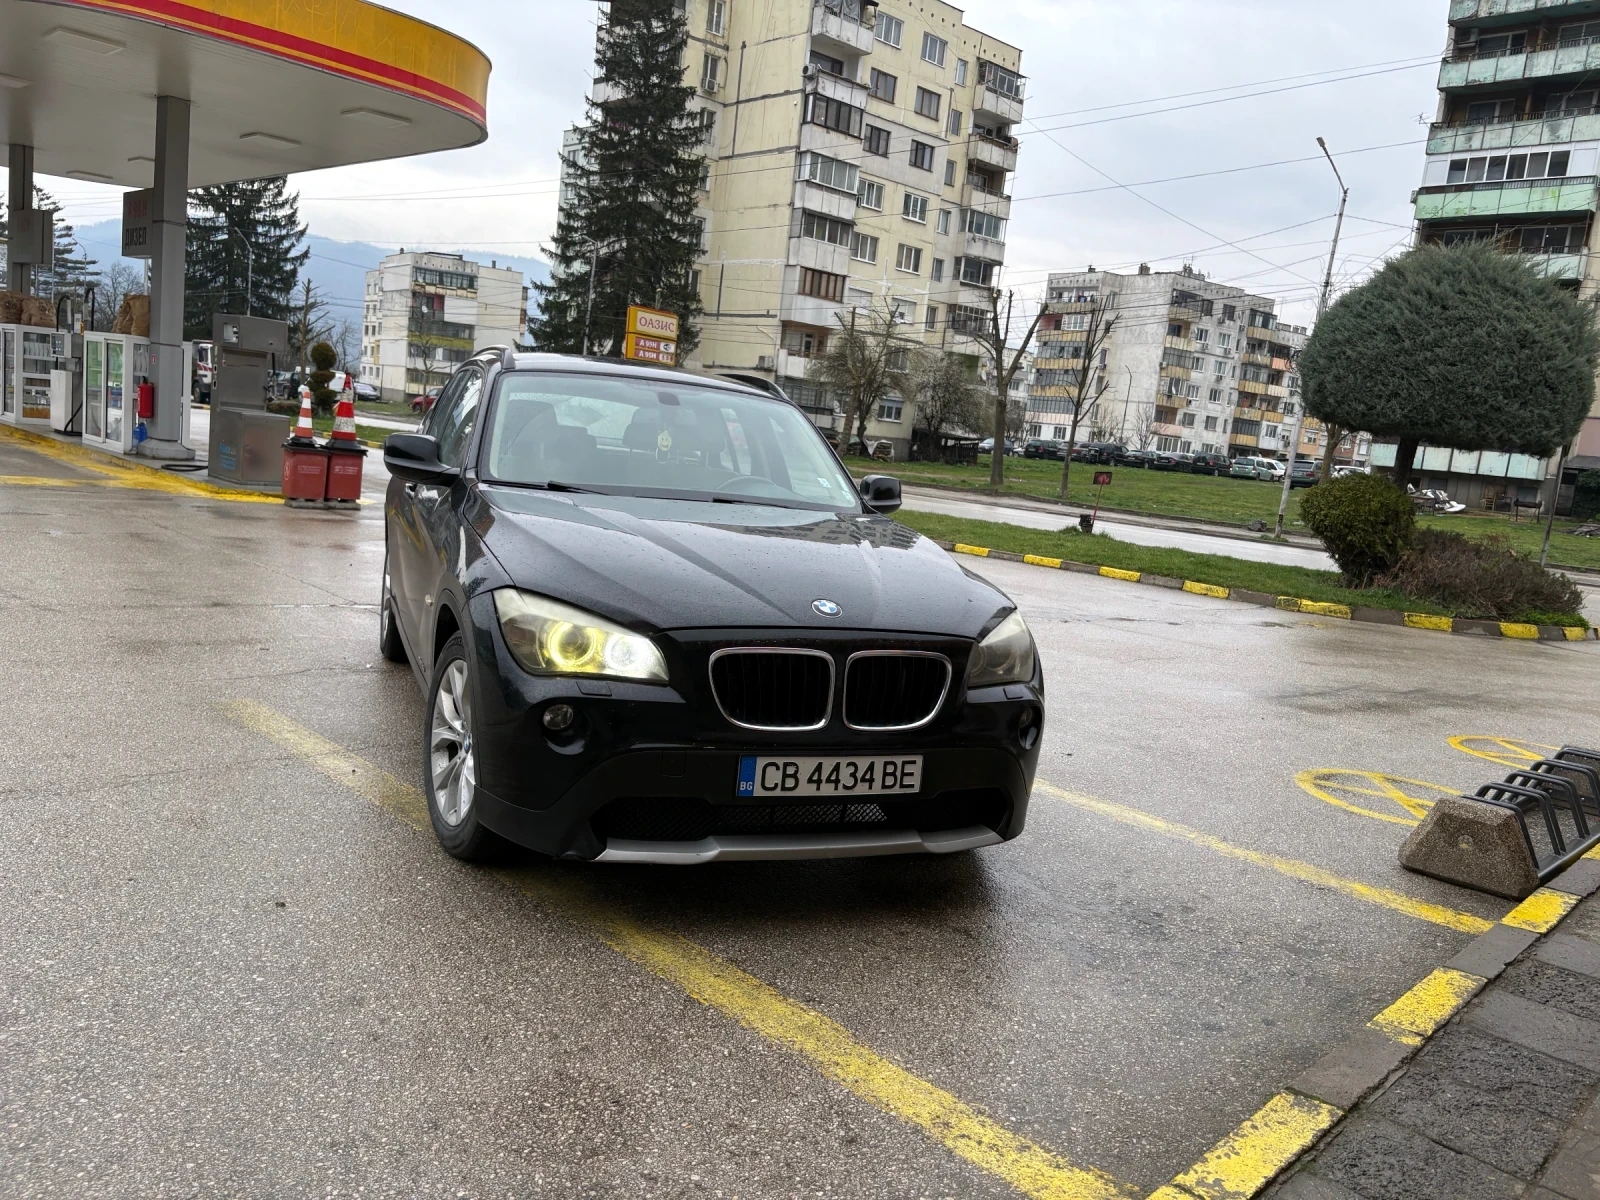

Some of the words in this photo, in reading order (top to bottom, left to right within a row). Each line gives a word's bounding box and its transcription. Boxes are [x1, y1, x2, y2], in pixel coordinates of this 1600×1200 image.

[639, 316, 675, 332] ОАЗИС
[760, 761, 800, 792] CB
[806, 760, 876, 792] 4434
[881, 760, 917, 790] BE
[739, 781, 753, 791] BG
